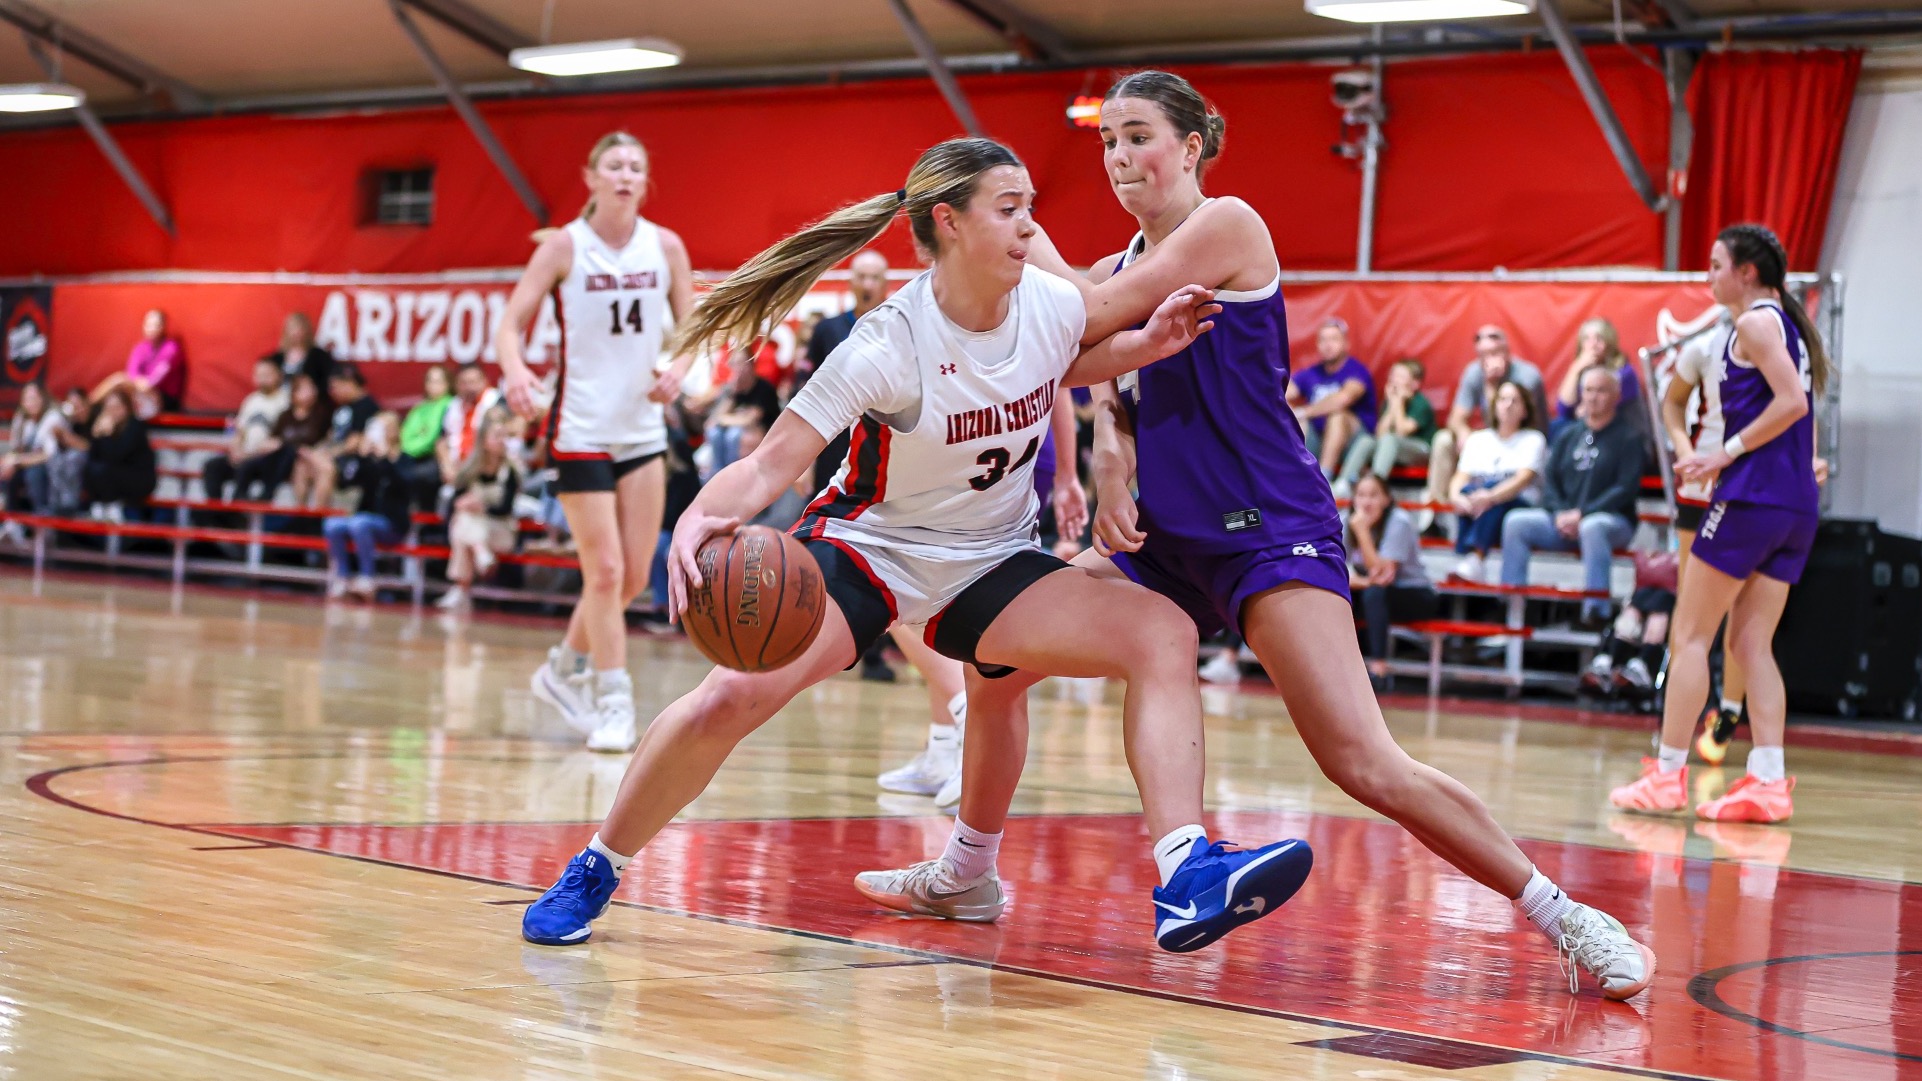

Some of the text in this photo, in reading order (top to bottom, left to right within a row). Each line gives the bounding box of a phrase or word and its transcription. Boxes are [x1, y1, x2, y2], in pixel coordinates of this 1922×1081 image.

[609, 299, 643, 334] 14
[945, 404, 1003, 446] ARIZONA
[1247, 513, 1257, 523] XL
[1701, 502, 1727, 540] TROJ
